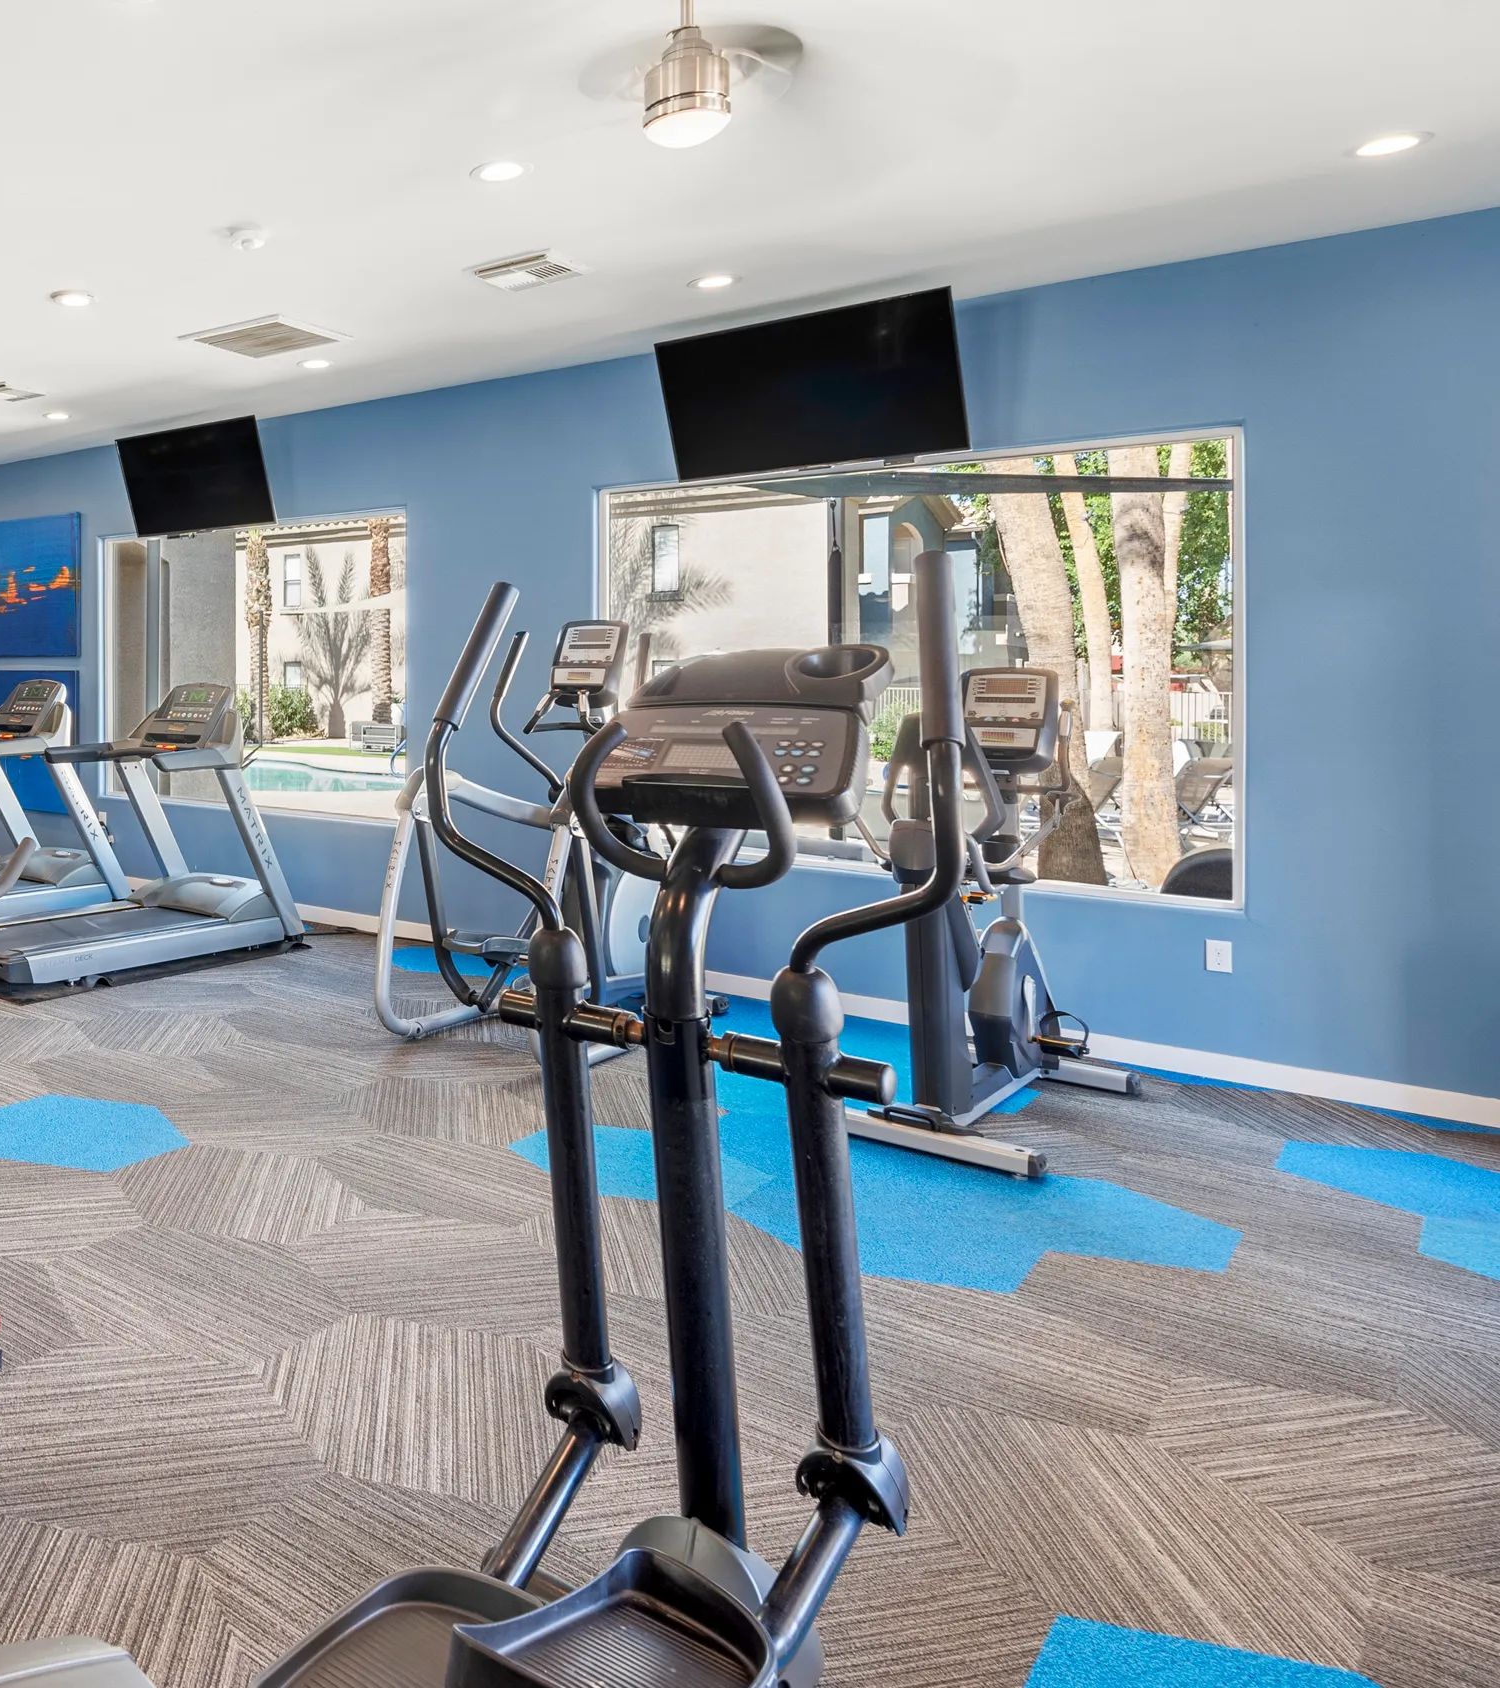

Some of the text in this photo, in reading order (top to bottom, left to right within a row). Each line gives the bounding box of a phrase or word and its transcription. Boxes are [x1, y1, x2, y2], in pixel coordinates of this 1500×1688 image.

[237, 786, 273, 869] MATRIX
[385, 840, 402, 889] MATRIX
[545, 859, 559, 891] MATR
[74, 954, 94, 963] DECK
